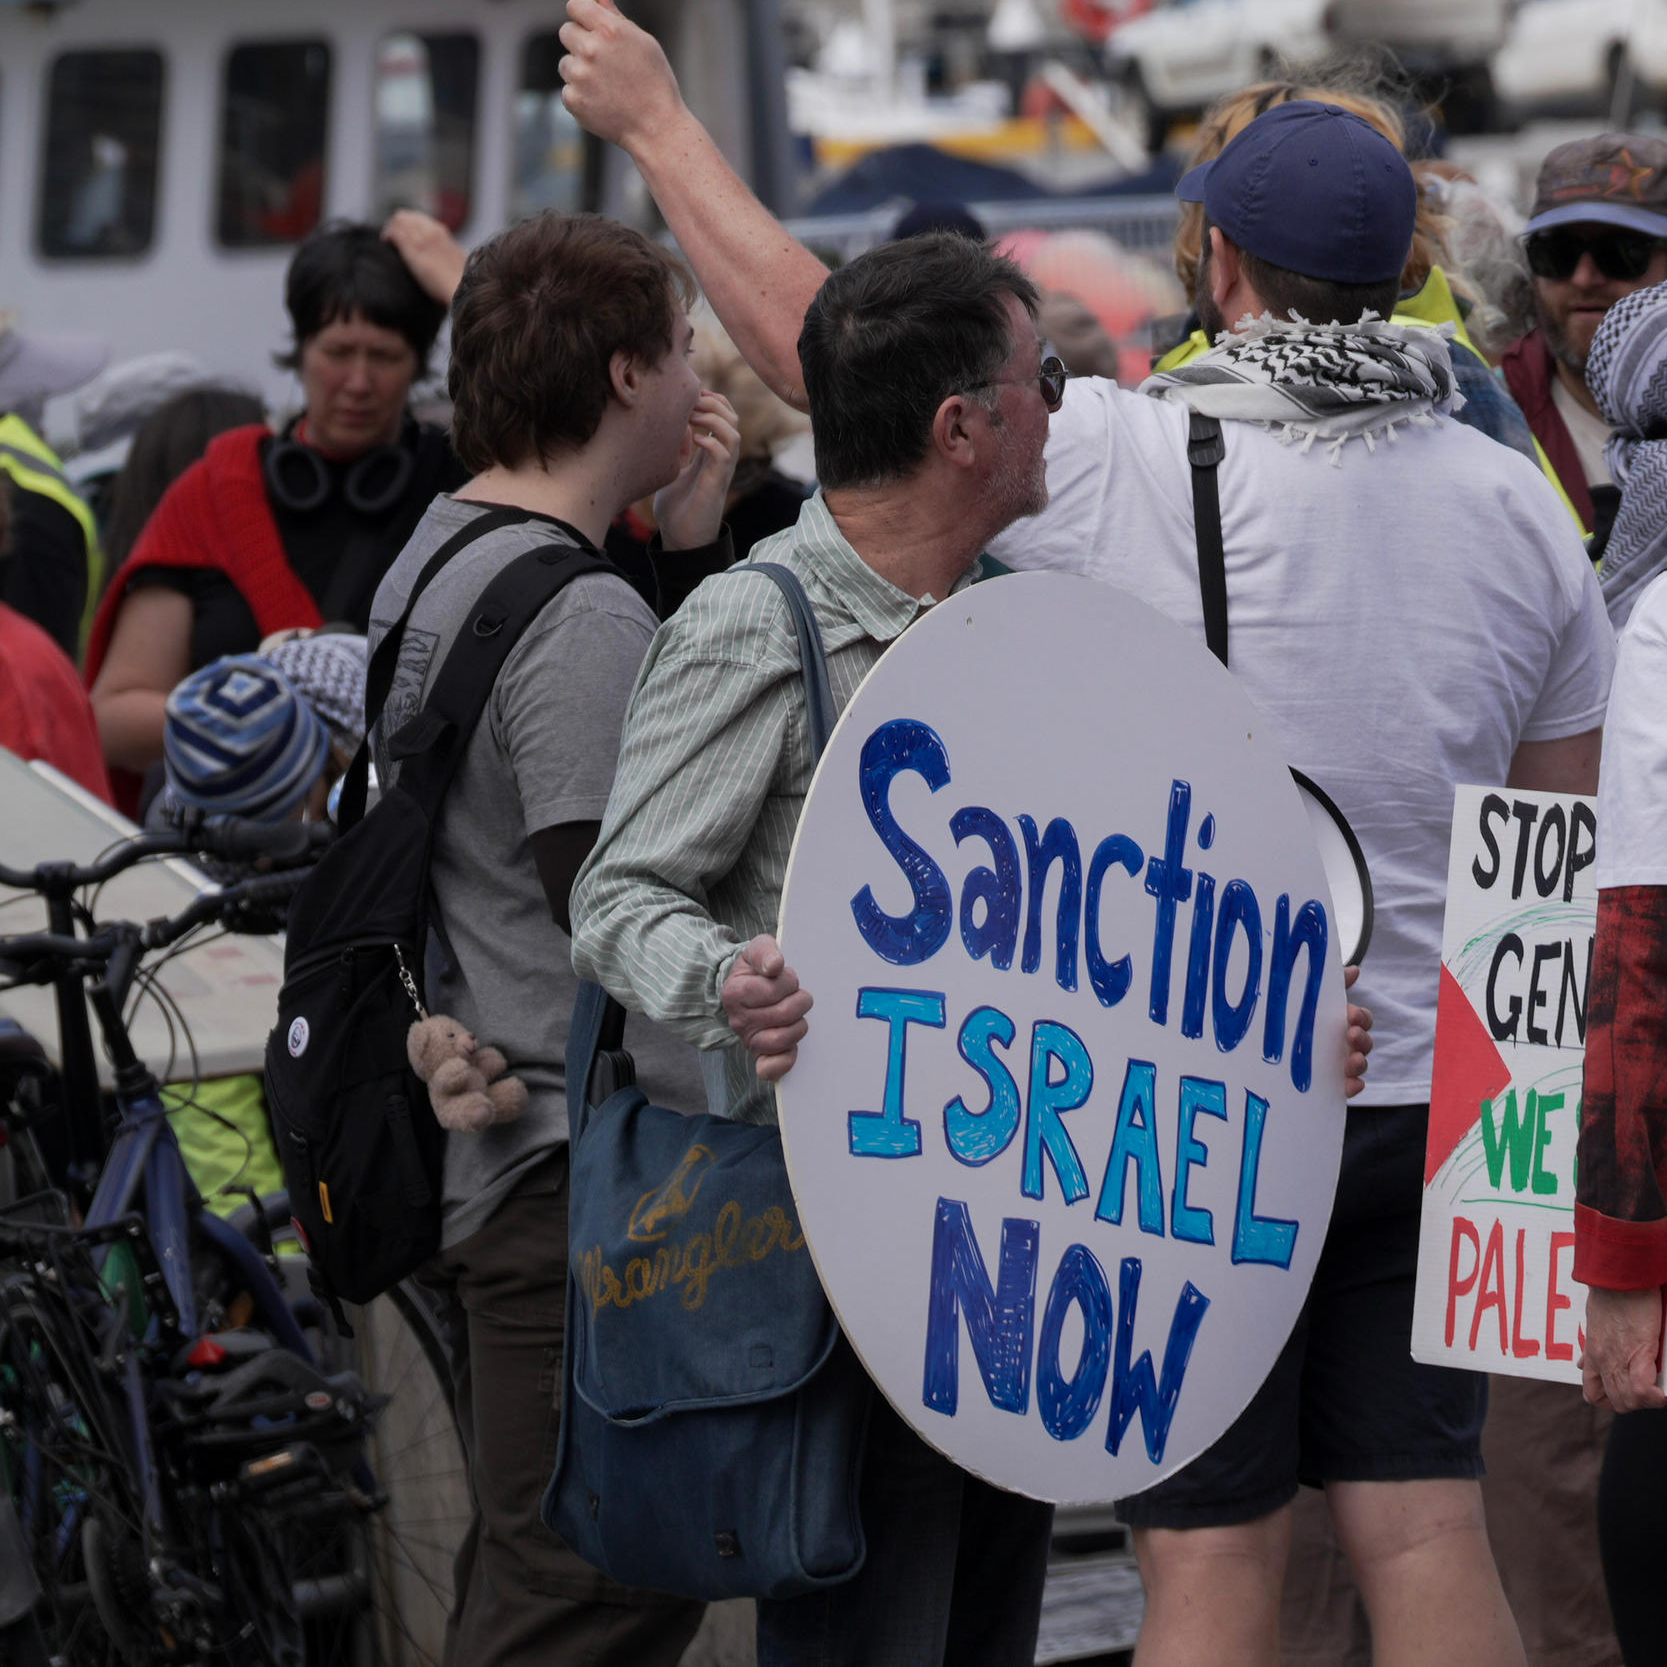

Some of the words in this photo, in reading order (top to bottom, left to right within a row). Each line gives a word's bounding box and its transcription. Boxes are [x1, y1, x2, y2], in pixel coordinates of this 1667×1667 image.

[849, 718, 1329, 1094] Sanction
[1471, 793, 1597, 903] STOP
[847, 986, 1299, 1272] ISRAEL
[1479, 1086, 1565, 1195] WE
[574, 1200, 804, 1323] Wrangler
[922, 1196, 1212, 1466] NOW
